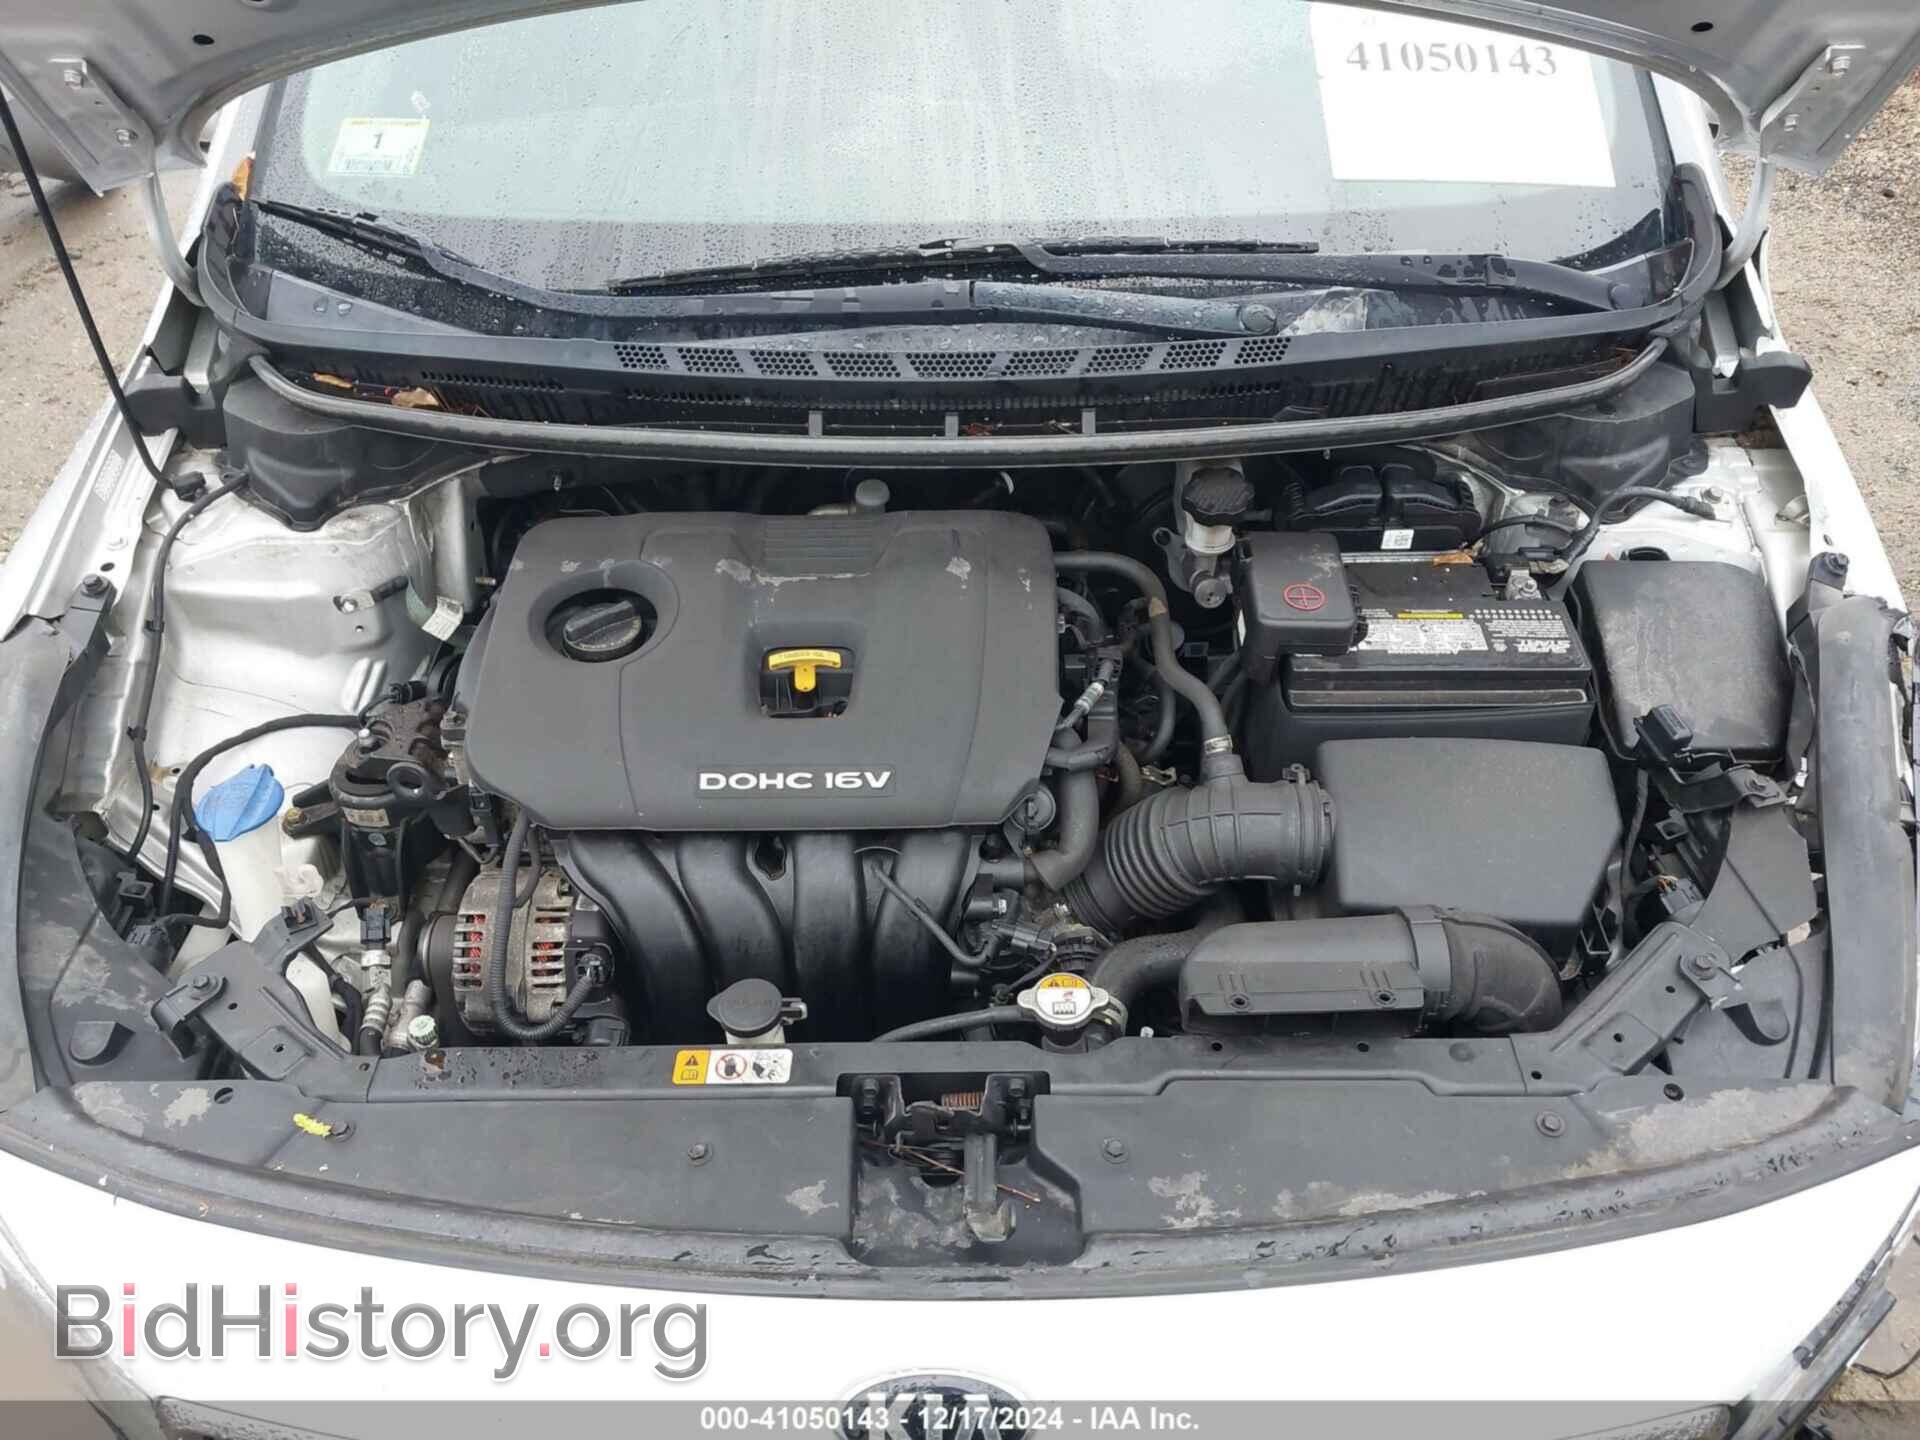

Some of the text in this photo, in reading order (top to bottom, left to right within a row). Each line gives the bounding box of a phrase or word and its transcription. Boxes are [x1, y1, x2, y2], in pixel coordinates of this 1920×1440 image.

[1346, 41, 1557, 76] 41050143
[699, 771, 891, 790] DOHC 16V
